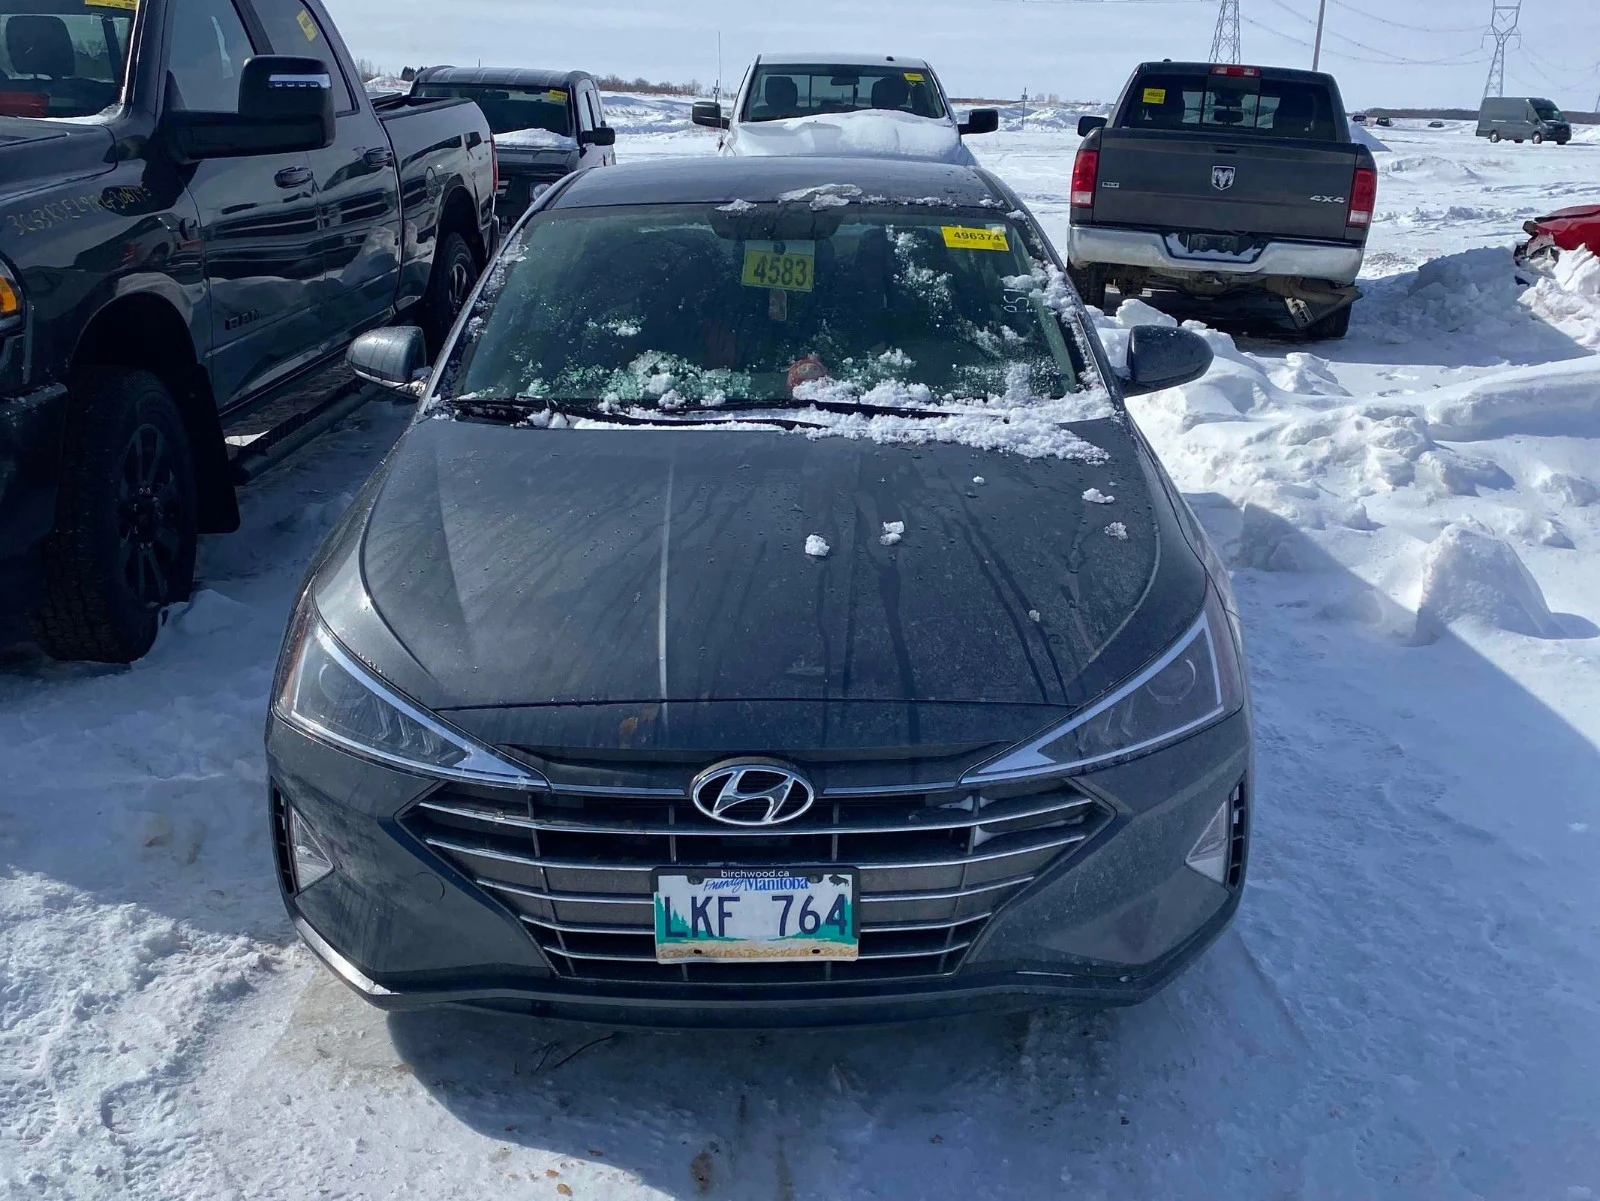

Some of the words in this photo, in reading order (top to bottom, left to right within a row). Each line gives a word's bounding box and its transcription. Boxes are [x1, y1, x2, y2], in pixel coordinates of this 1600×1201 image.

[953, 231, 1002, 242] 496374
[753, 254, 807, 287] 4583
[720, 869, 790, 878] birchwood.ca
[744, 876, 810, 892] Manitoba
[664, 896, 741, 938] LKF
[771, 894, 848, 937] 764
